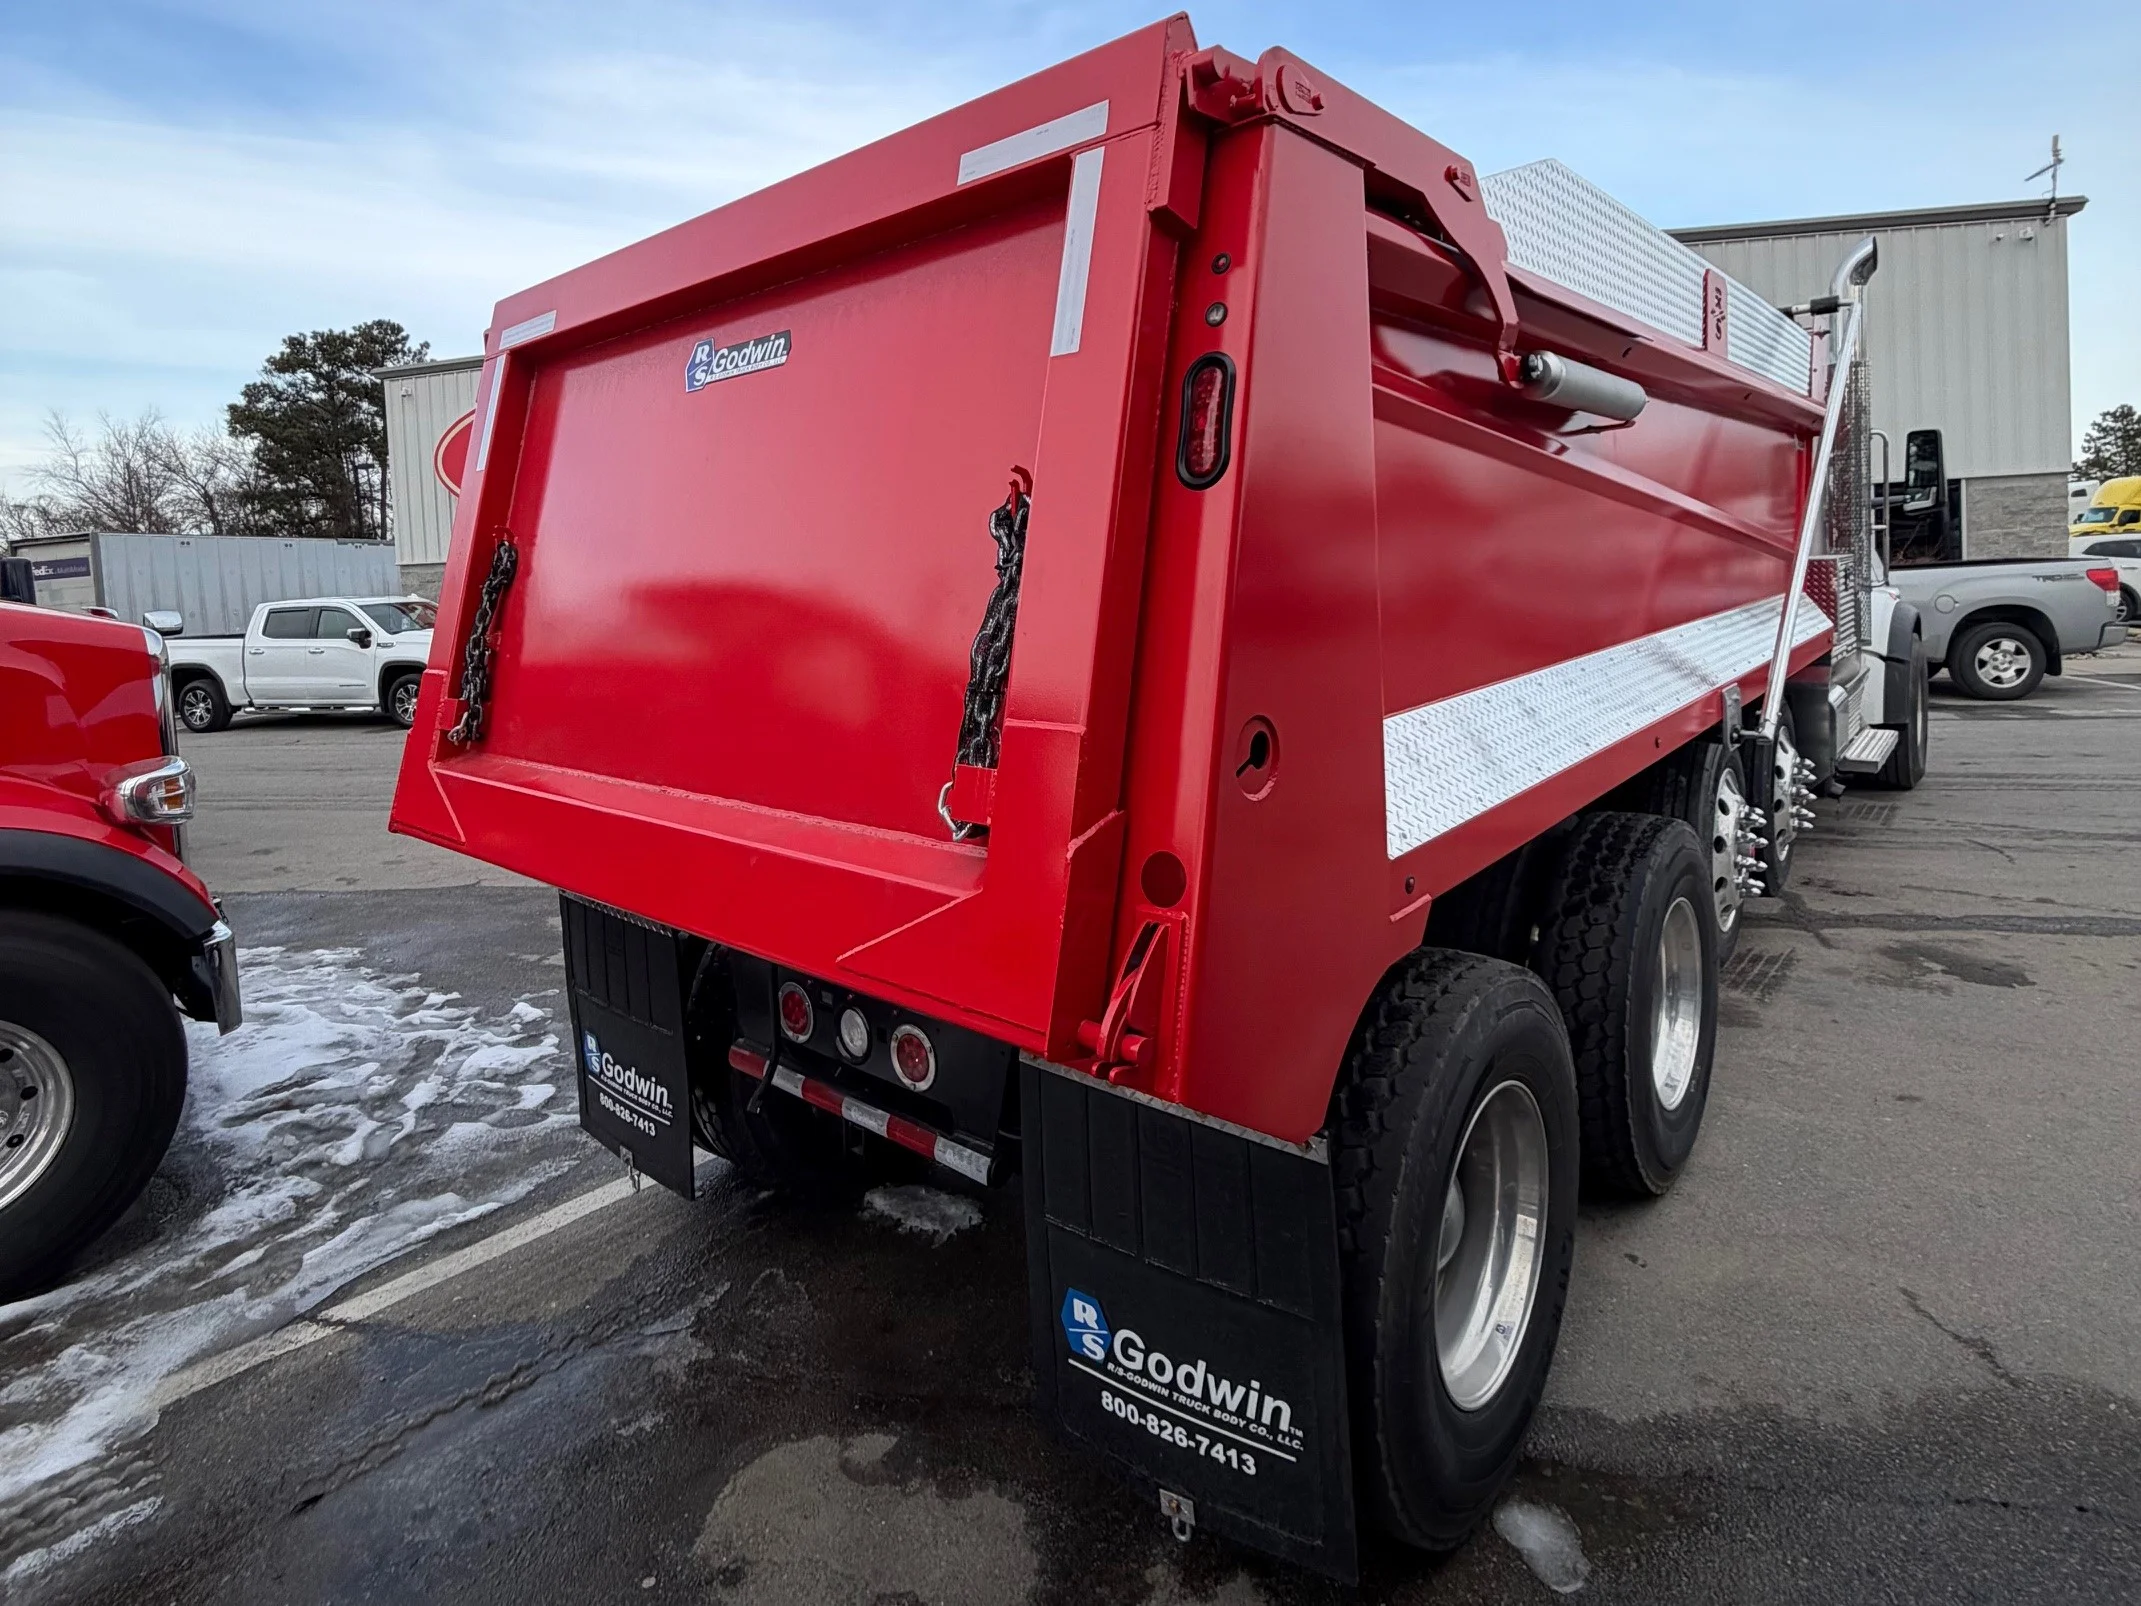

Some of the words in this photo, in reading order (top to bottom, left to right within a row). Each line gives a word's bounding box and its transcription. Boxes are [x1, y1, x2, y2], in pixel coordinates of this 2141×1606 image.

[712, 334, 786, 374] Godwin
[601, 1052, 668, 1108] Godwin
[599, 1091, 656, 1137] 800-826-7413
[1106, 1361, 1170, 1398] R/S-GODWIN
[1171, 1391, 1212, 1416] TRUCK
[1213, 1407, 1248, 1429] BODY
[1112, 1328, 1293, 1433] Godwin
[1100, 1389, 1258, 1476] 800-826-7413
